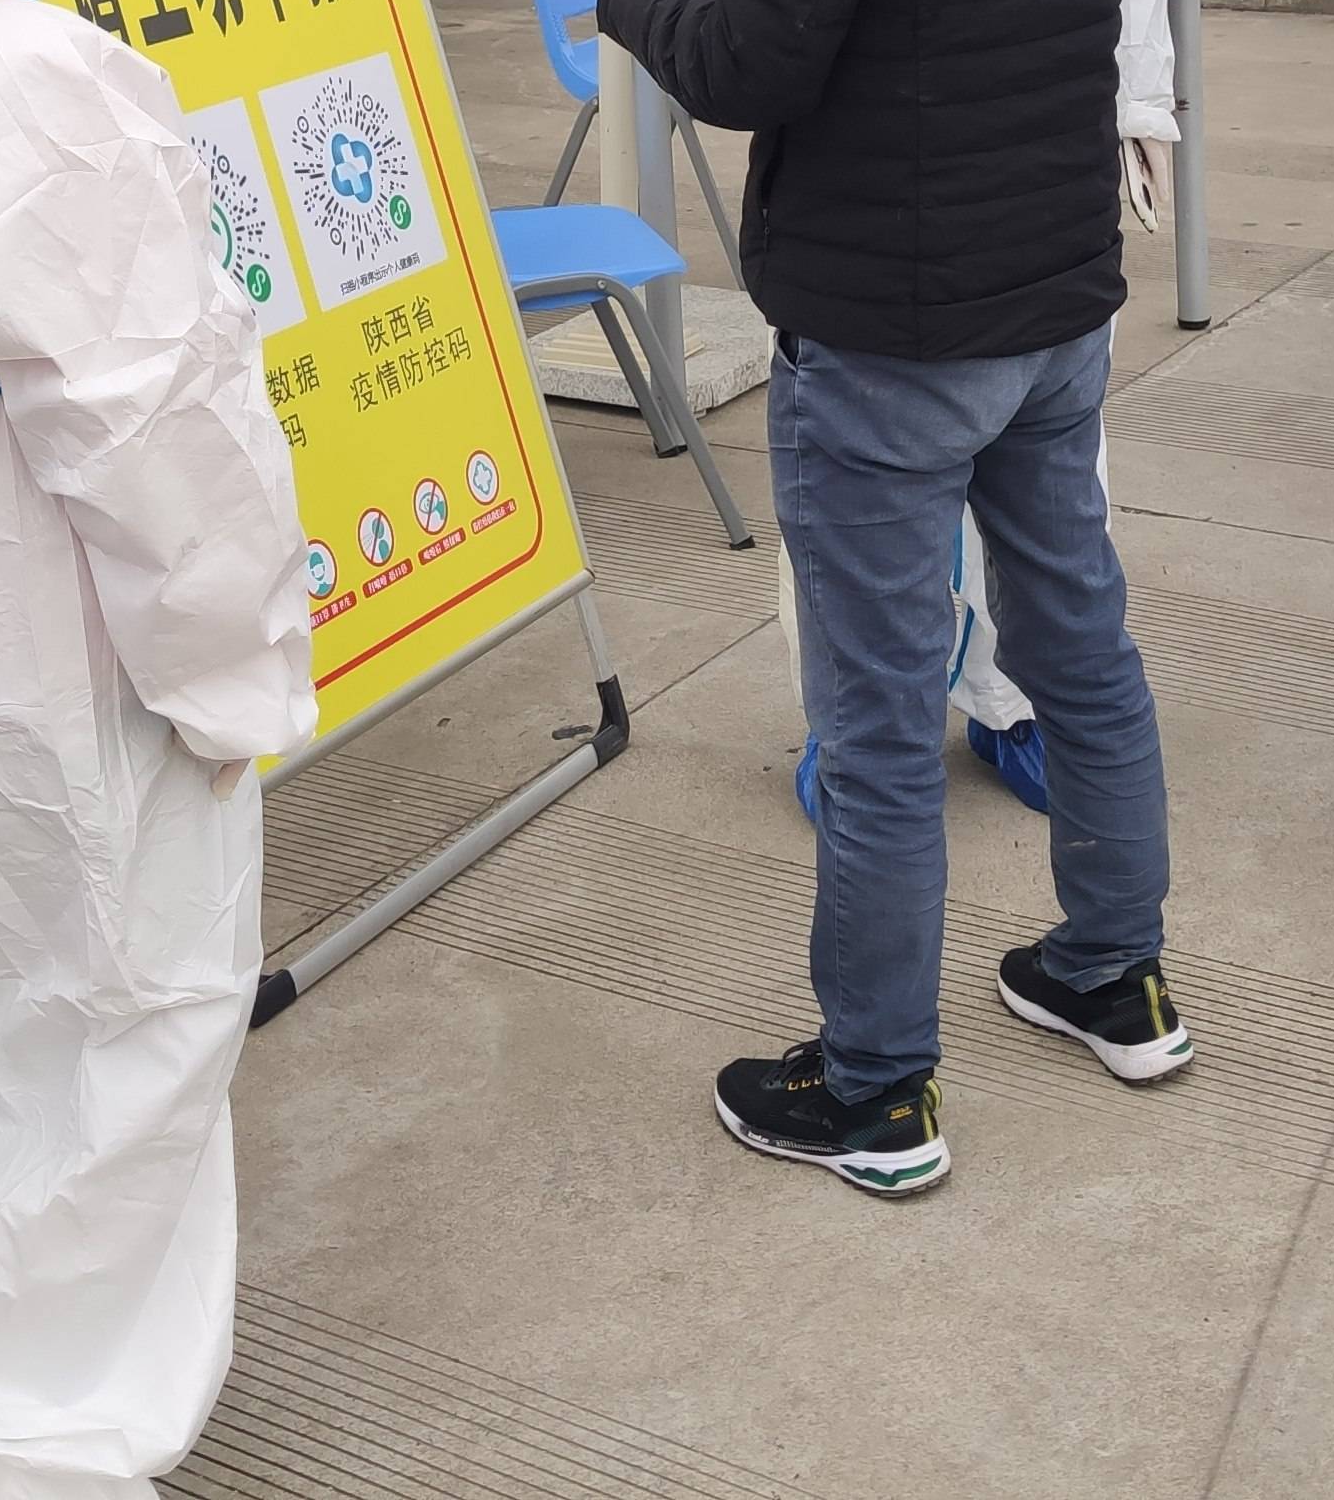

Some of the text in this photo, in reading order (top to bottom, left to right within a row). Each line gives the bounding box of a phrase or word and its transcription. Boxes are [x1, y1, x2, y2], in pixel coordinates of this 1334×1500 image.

[361, 295, 435, 356] 陕西省
[267, 352, 320, 408] 数据
[349, 326, 472, 413] 疫情防控码
